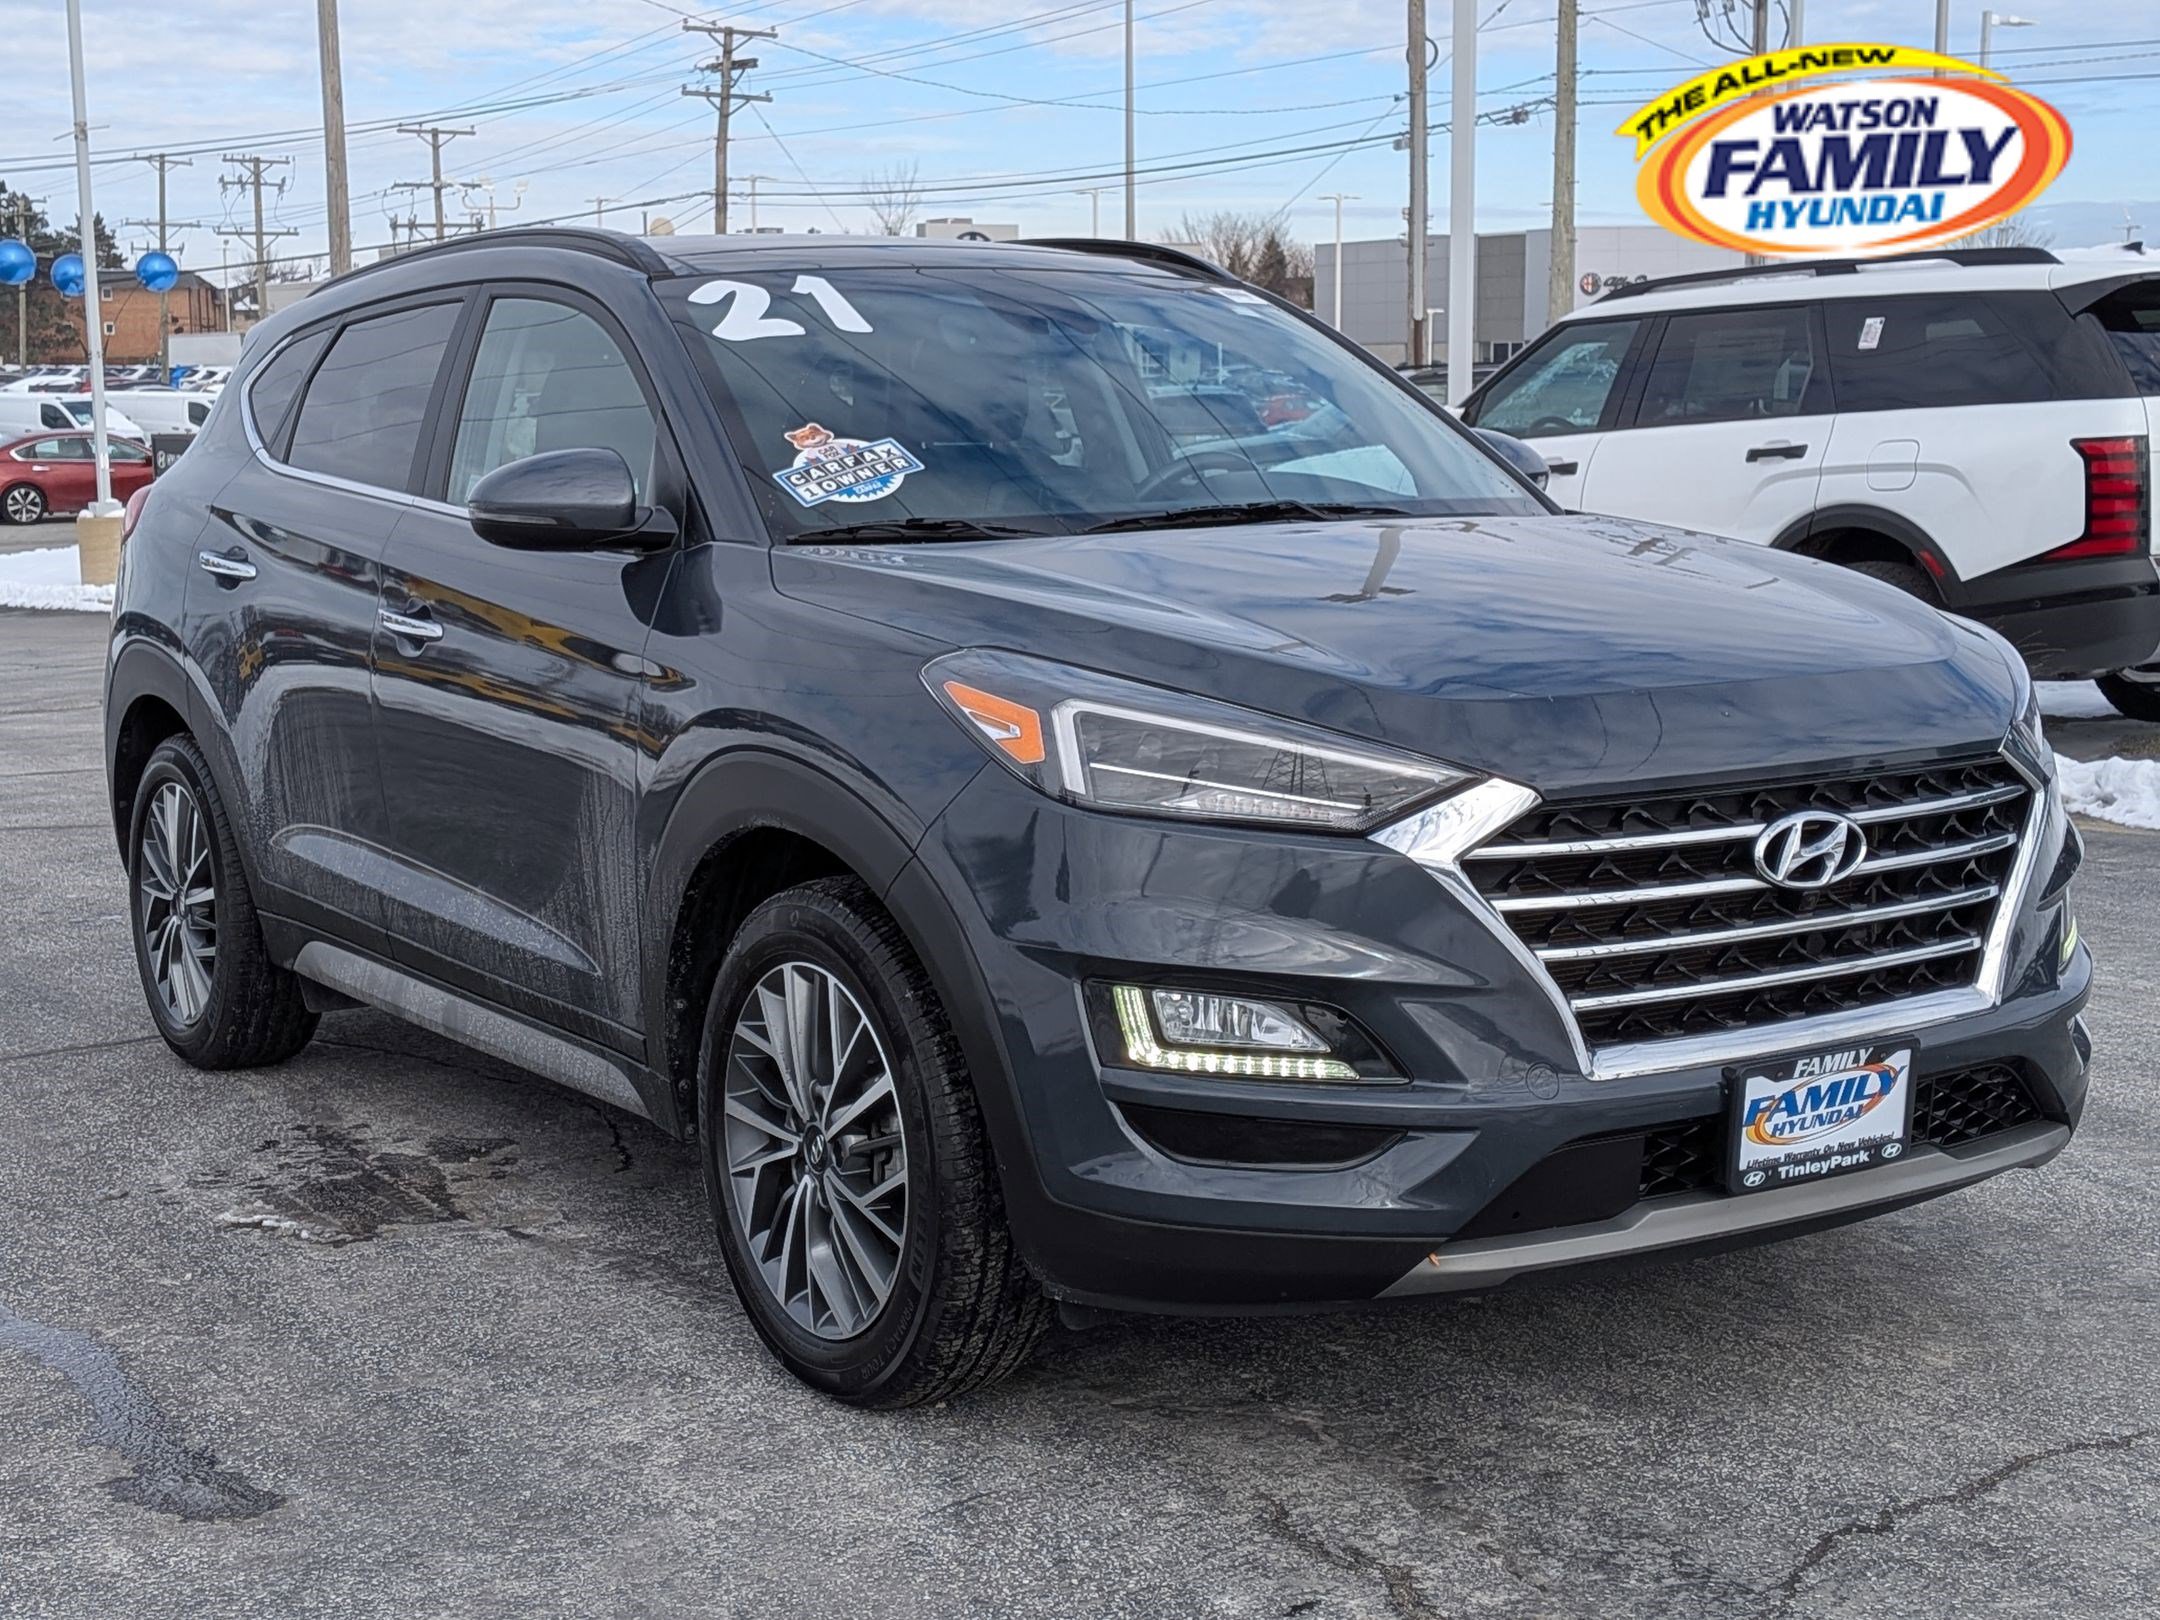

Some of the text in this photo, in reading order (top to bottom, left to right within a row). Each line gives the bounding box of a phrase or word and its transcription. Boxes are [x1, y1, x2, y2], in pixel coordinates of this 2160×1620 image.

[789, 448, 897, 485] CARFAX
[821, 457, 909, 492] OWNER
[1793, 1047, 1874, 1079] FAMILY
[1743, 1065, 1908, 1127] FAMILY
[1770, 1104, 1865, 1138] HYUNDAI
[1746, 1155, 1782, 1170] Lifetime
[1823, 1143, 1835, 1152] On
[1837, 1141, 1856, 1151] New
[1778, 1150, 1871, 1180] TinleyPark
